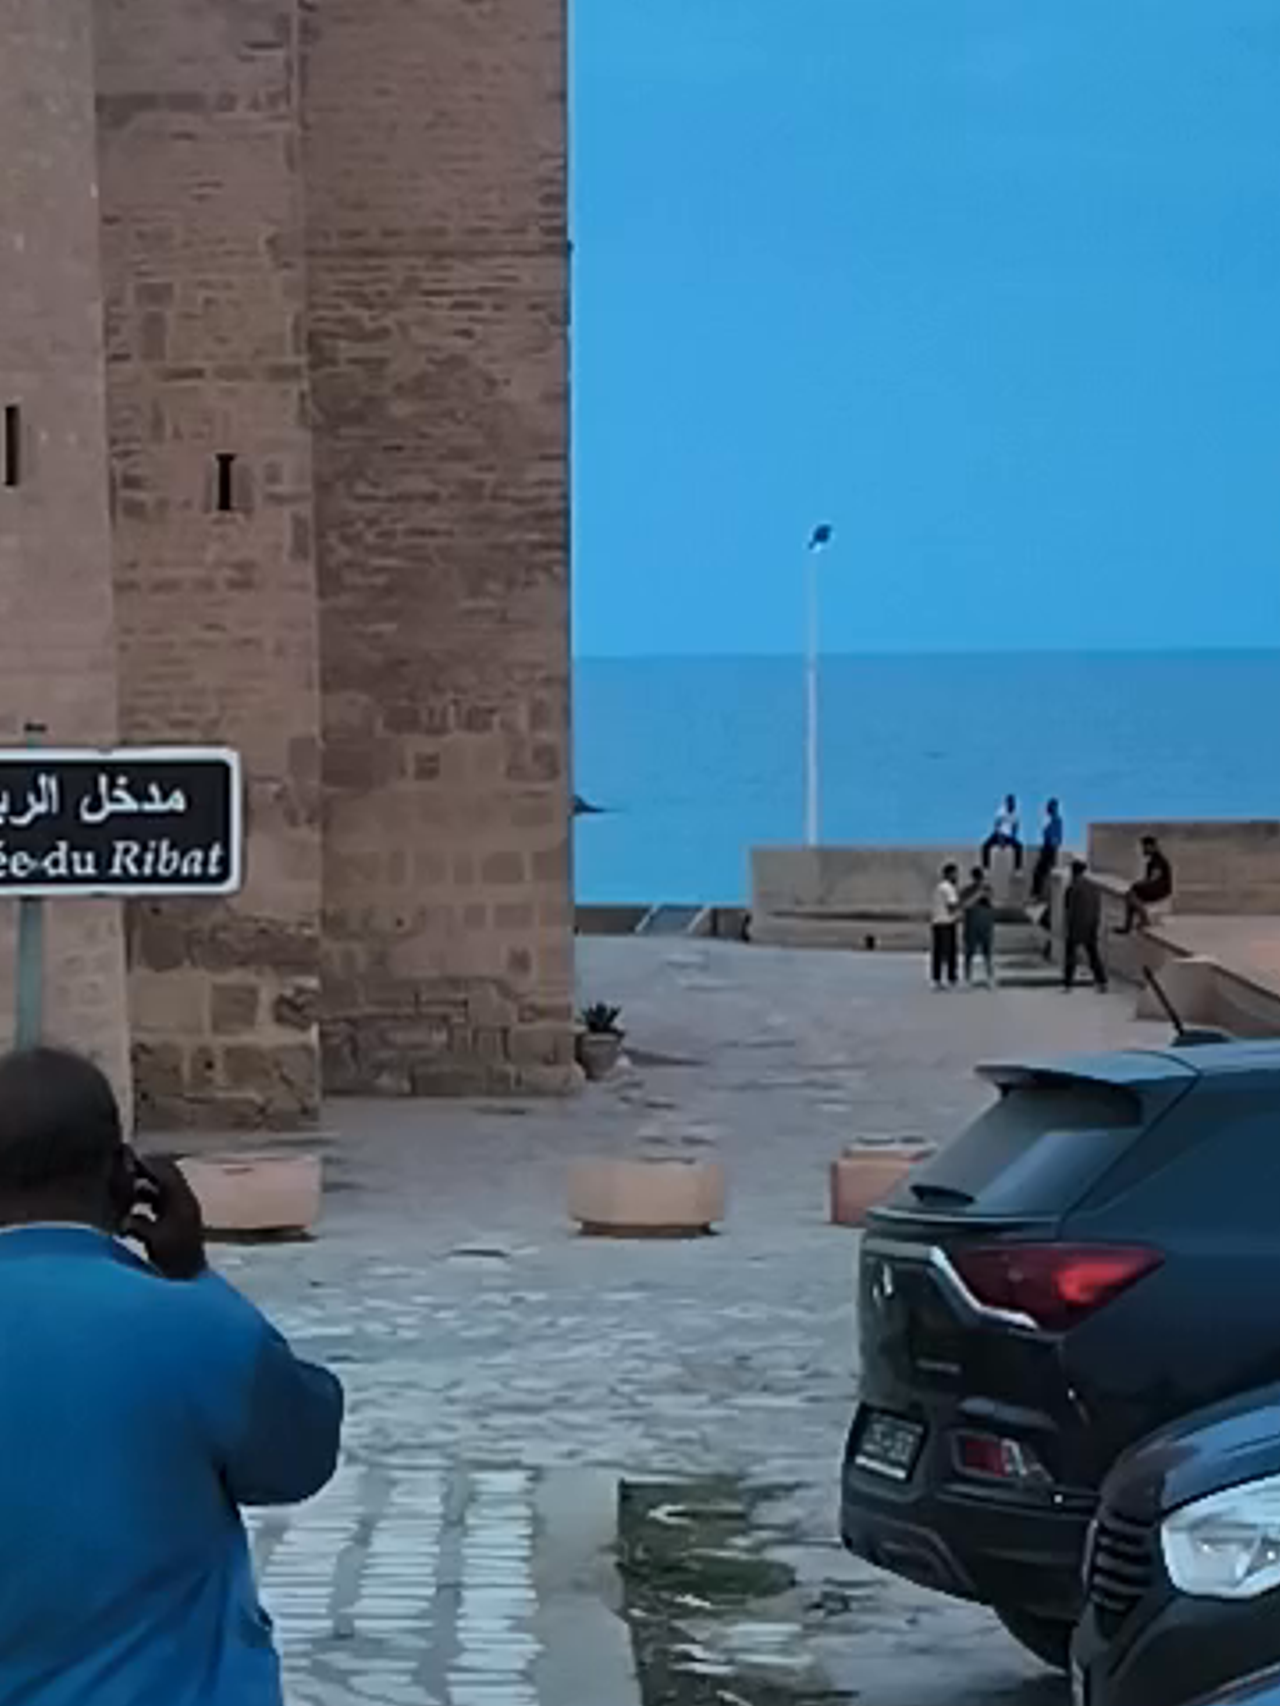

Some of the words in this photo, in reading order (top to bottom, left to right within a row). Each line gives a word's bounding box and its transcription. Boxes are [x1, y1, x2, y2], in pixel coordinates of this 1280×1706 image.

[80, 774, 187, 823] مدخل
[43, 839, 98, 877] du
[110, 838, 225, 877] Ribat
